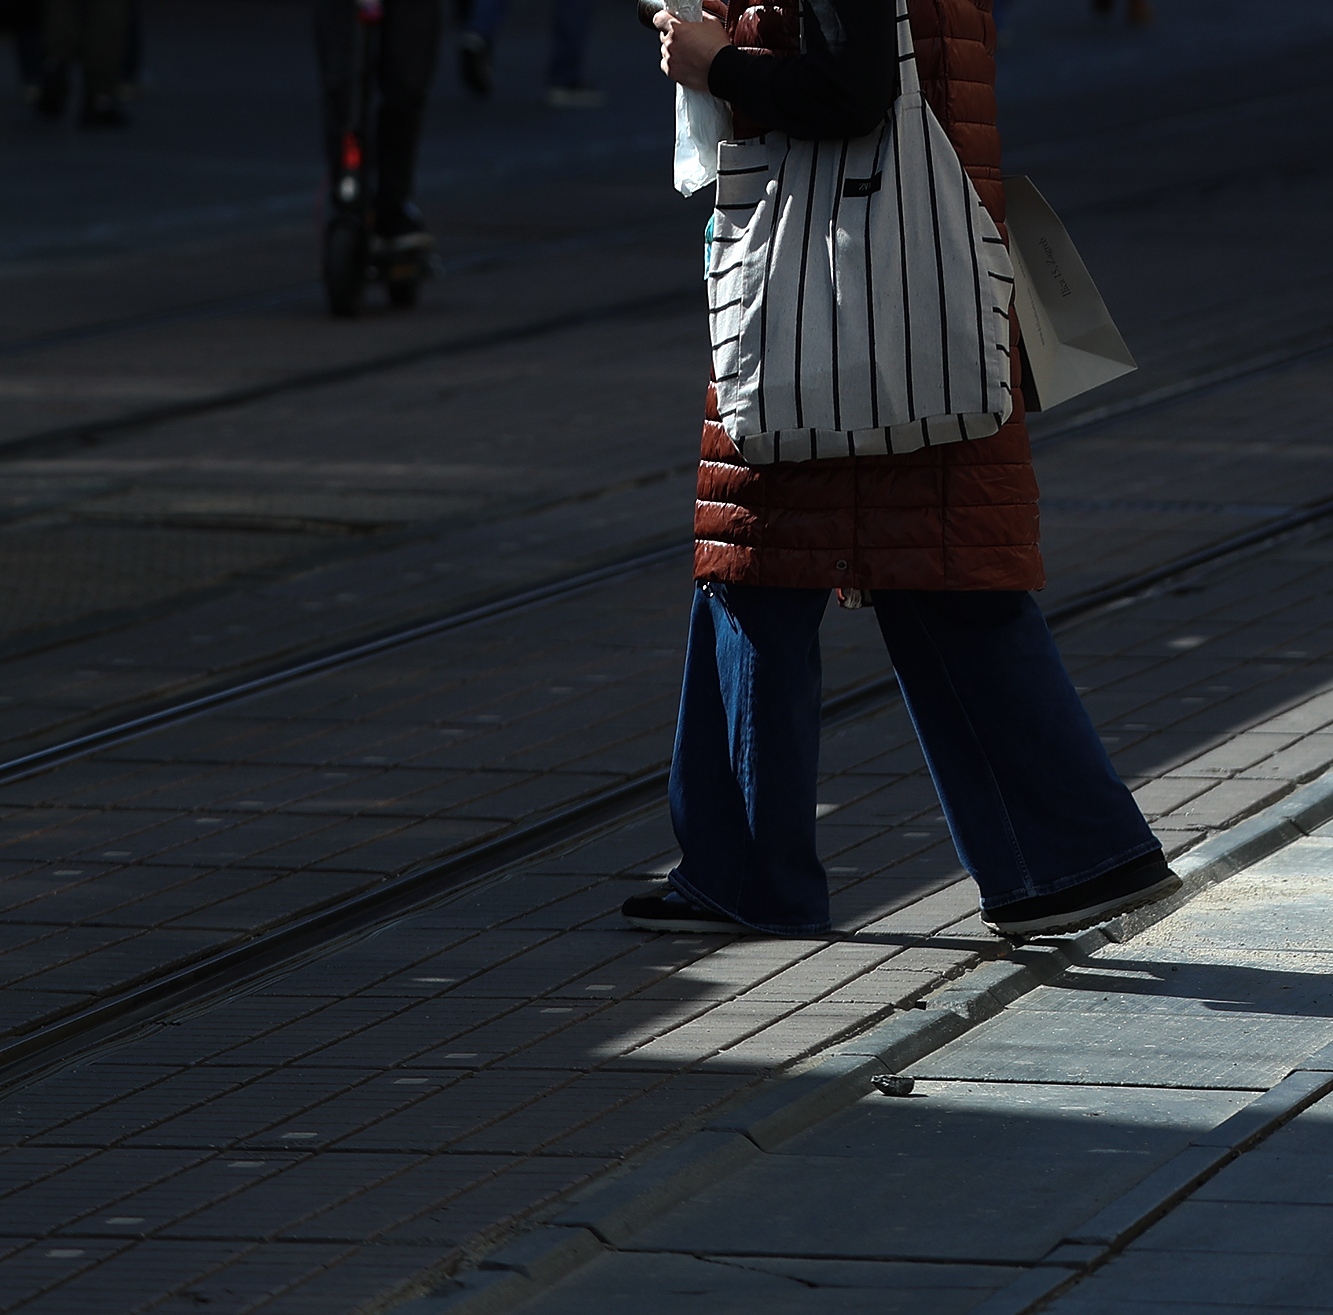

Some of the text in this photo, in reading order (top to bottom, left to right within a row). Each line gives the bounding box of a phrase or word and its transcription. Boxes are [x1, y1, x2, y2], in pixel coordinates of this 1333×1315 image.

[1038, 237, 1072, 298] Ilica 15, Zagreb
